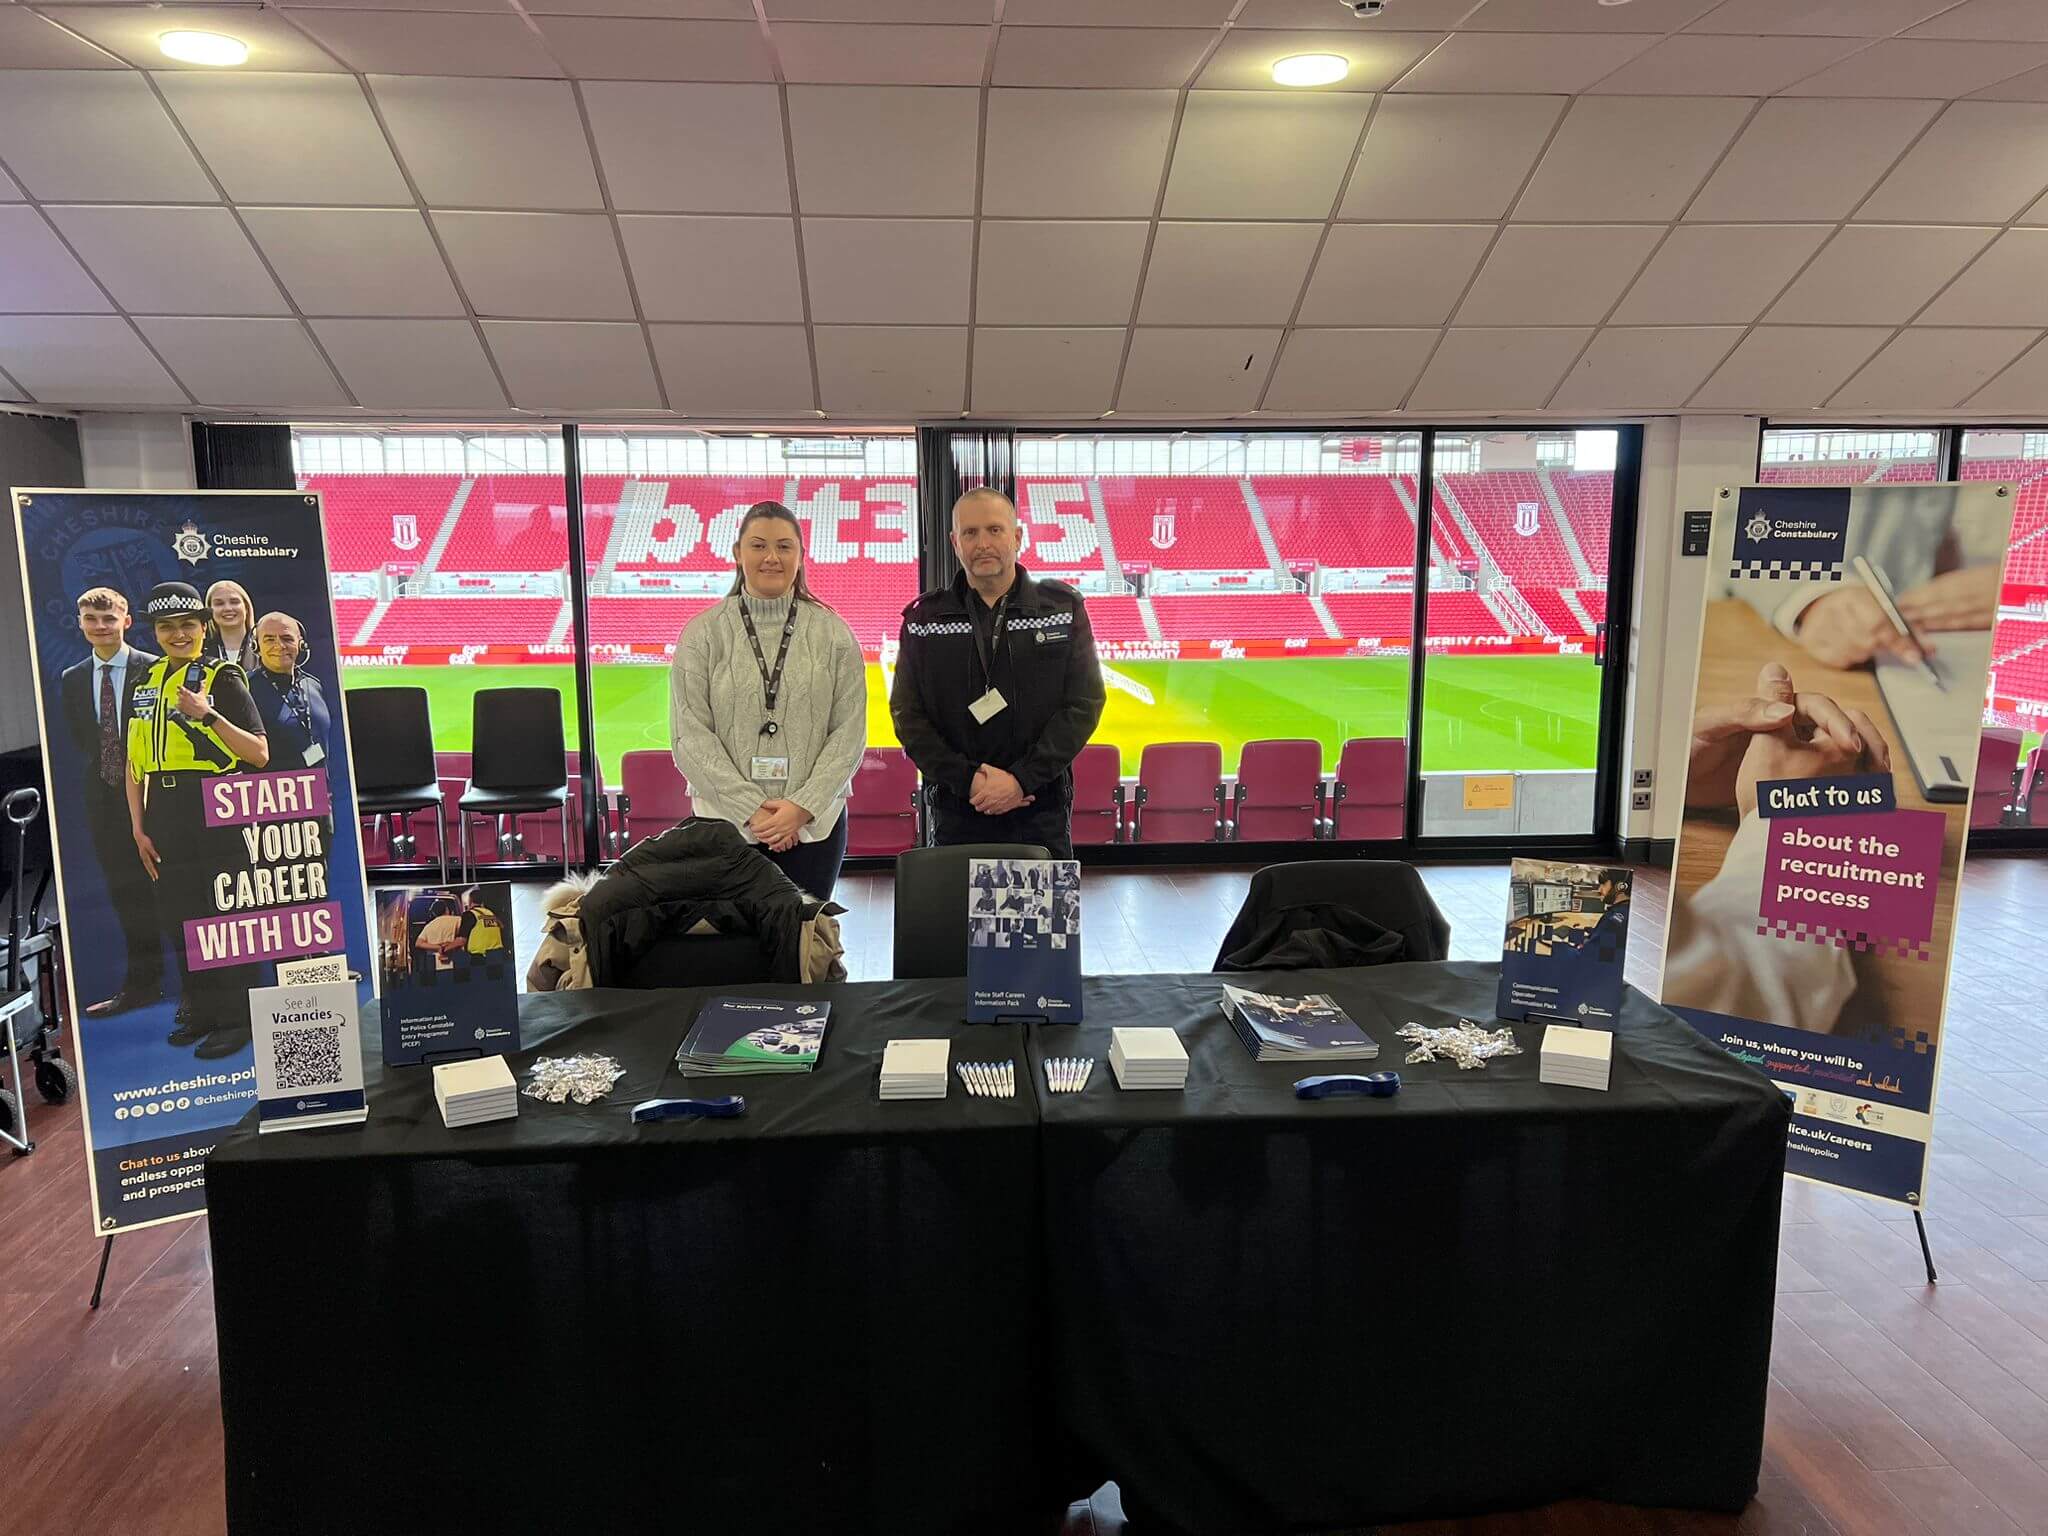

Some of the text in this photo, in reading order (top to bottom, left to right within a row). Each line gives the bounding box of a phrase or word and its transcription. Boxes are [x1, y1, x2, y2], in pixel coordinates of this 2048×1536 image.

[617, 482, 1101, 565] bt35
[1774, 520, 1817, 529] Cheshire
[213, 534, 269, 545] Cheshire
[1773, 530, 1839, 540] Constabulary
[214, 547, 299, 559] Constabulary
[213, 774, 316, 819] START
[1769, 785, 1882, 809] Chat to us
[242, 821, 322, 864] YOUR
[1782, 828, 1900, 857] about the
[1780, 858, 1925, 889] recruitment
[213, 862, 327, 912] CAREER
[1776, 884, 1870, 909] process
[196, 909, 333, 961] WITH US
[284, 996, 318, 1010] See all
[1004, 991, 1026, 999] Careers
[1006, 999, 1020, 1007] Pack
[271, 1009, 332, 1024] Vacancies
[401, 1014, 447, 1025] Information pack
[427, 1021, 455, 1030] Constable
[417, 1030, 449, 1039] Programme
[401, 1041, 421, 1049] (PCEP)
[1720, 1033, 1863, 1070] Join us, where you will be
[1855, 1072, 1873, 1087] and
[1787, 1122, 1872, 1151] lice.uk/careers
[1786, 1140, 1840, 1160] heshirepolice
[119, 1157, 149, 1171] Chat
[150, 1156, 164, 1166] to
[166, 1152, 181, 1162] us
[120, 1170, 168, 1187] endless
[122, 1187, 146, 1202] and
